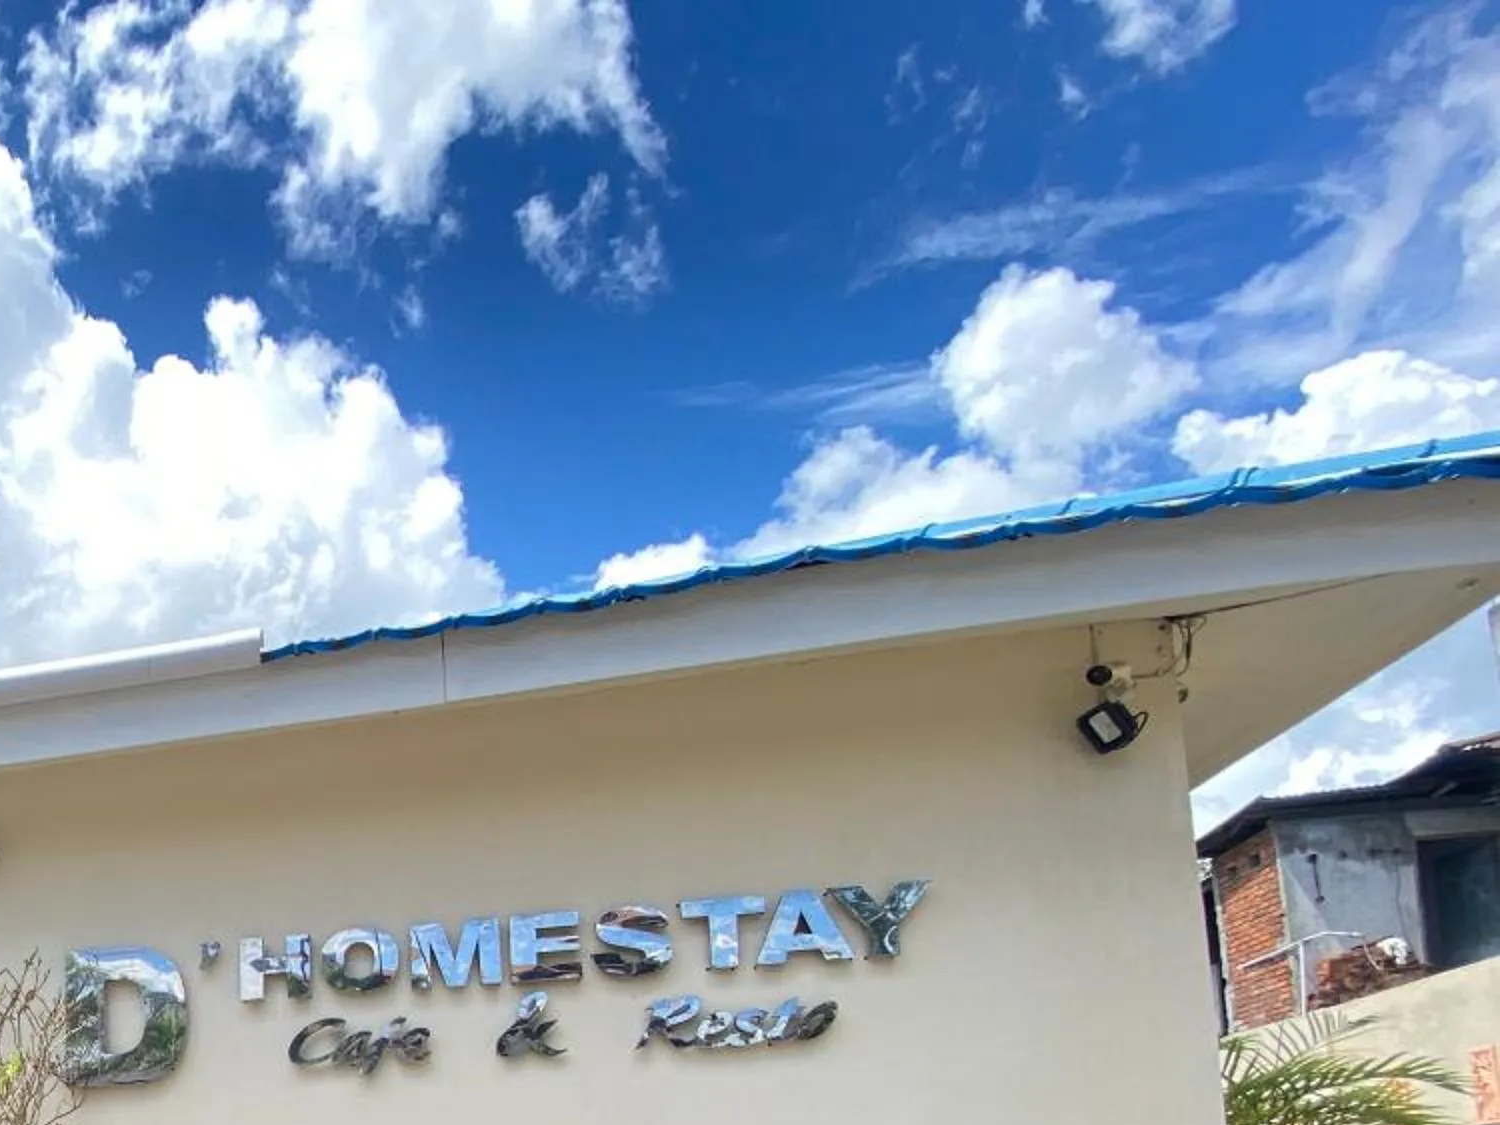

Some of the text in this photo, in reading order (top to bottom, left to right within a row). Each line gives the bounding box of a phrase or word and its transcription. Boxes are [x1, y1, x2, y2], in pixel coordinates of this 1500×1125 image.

[288, 991, 839, 1075] Cafe & Resto
